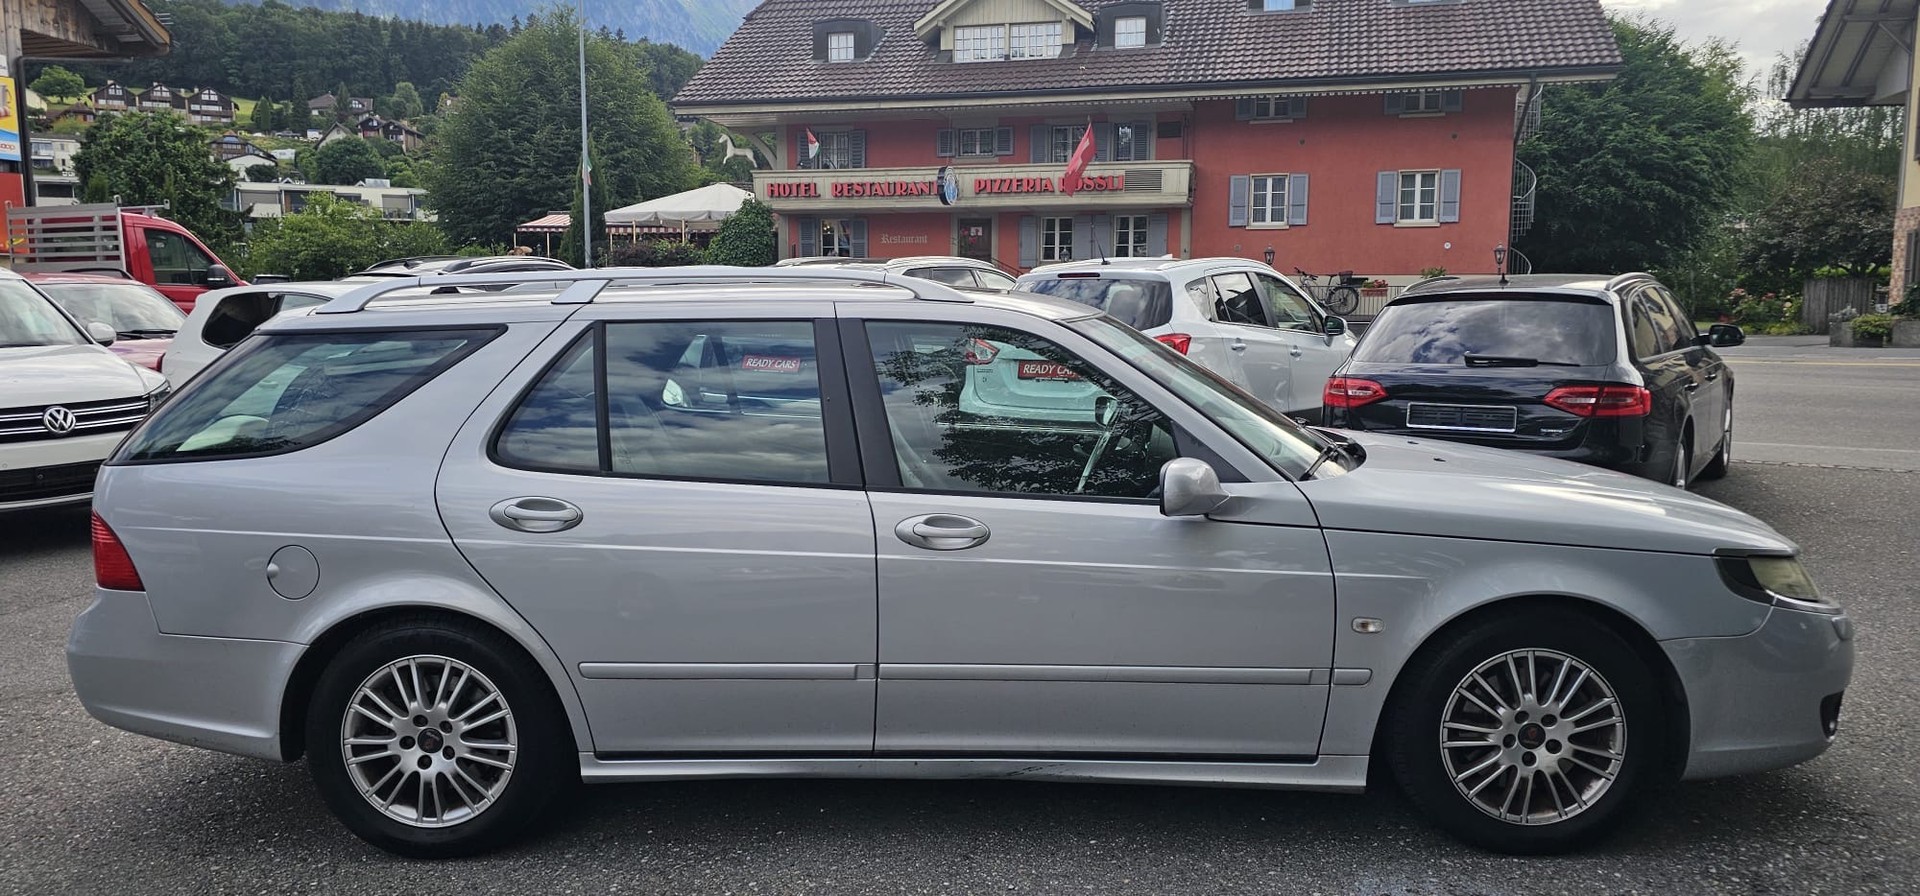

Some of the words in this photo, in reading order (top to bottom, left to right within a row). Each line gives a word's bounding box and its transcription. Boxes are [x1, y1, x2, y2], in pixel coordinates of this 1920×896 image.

[767, 182, 821, 197] HOTEL
[831, 181, 938, 197] RESTAURANT
[974, 177, 1054, 194] PIZZERIA
[880, 233, 928, 244] Restaurant
[746, 358, 774, 368] READY
[775, 360, 796, 369] CARS
[1023, 364, 1055, 374] READY
